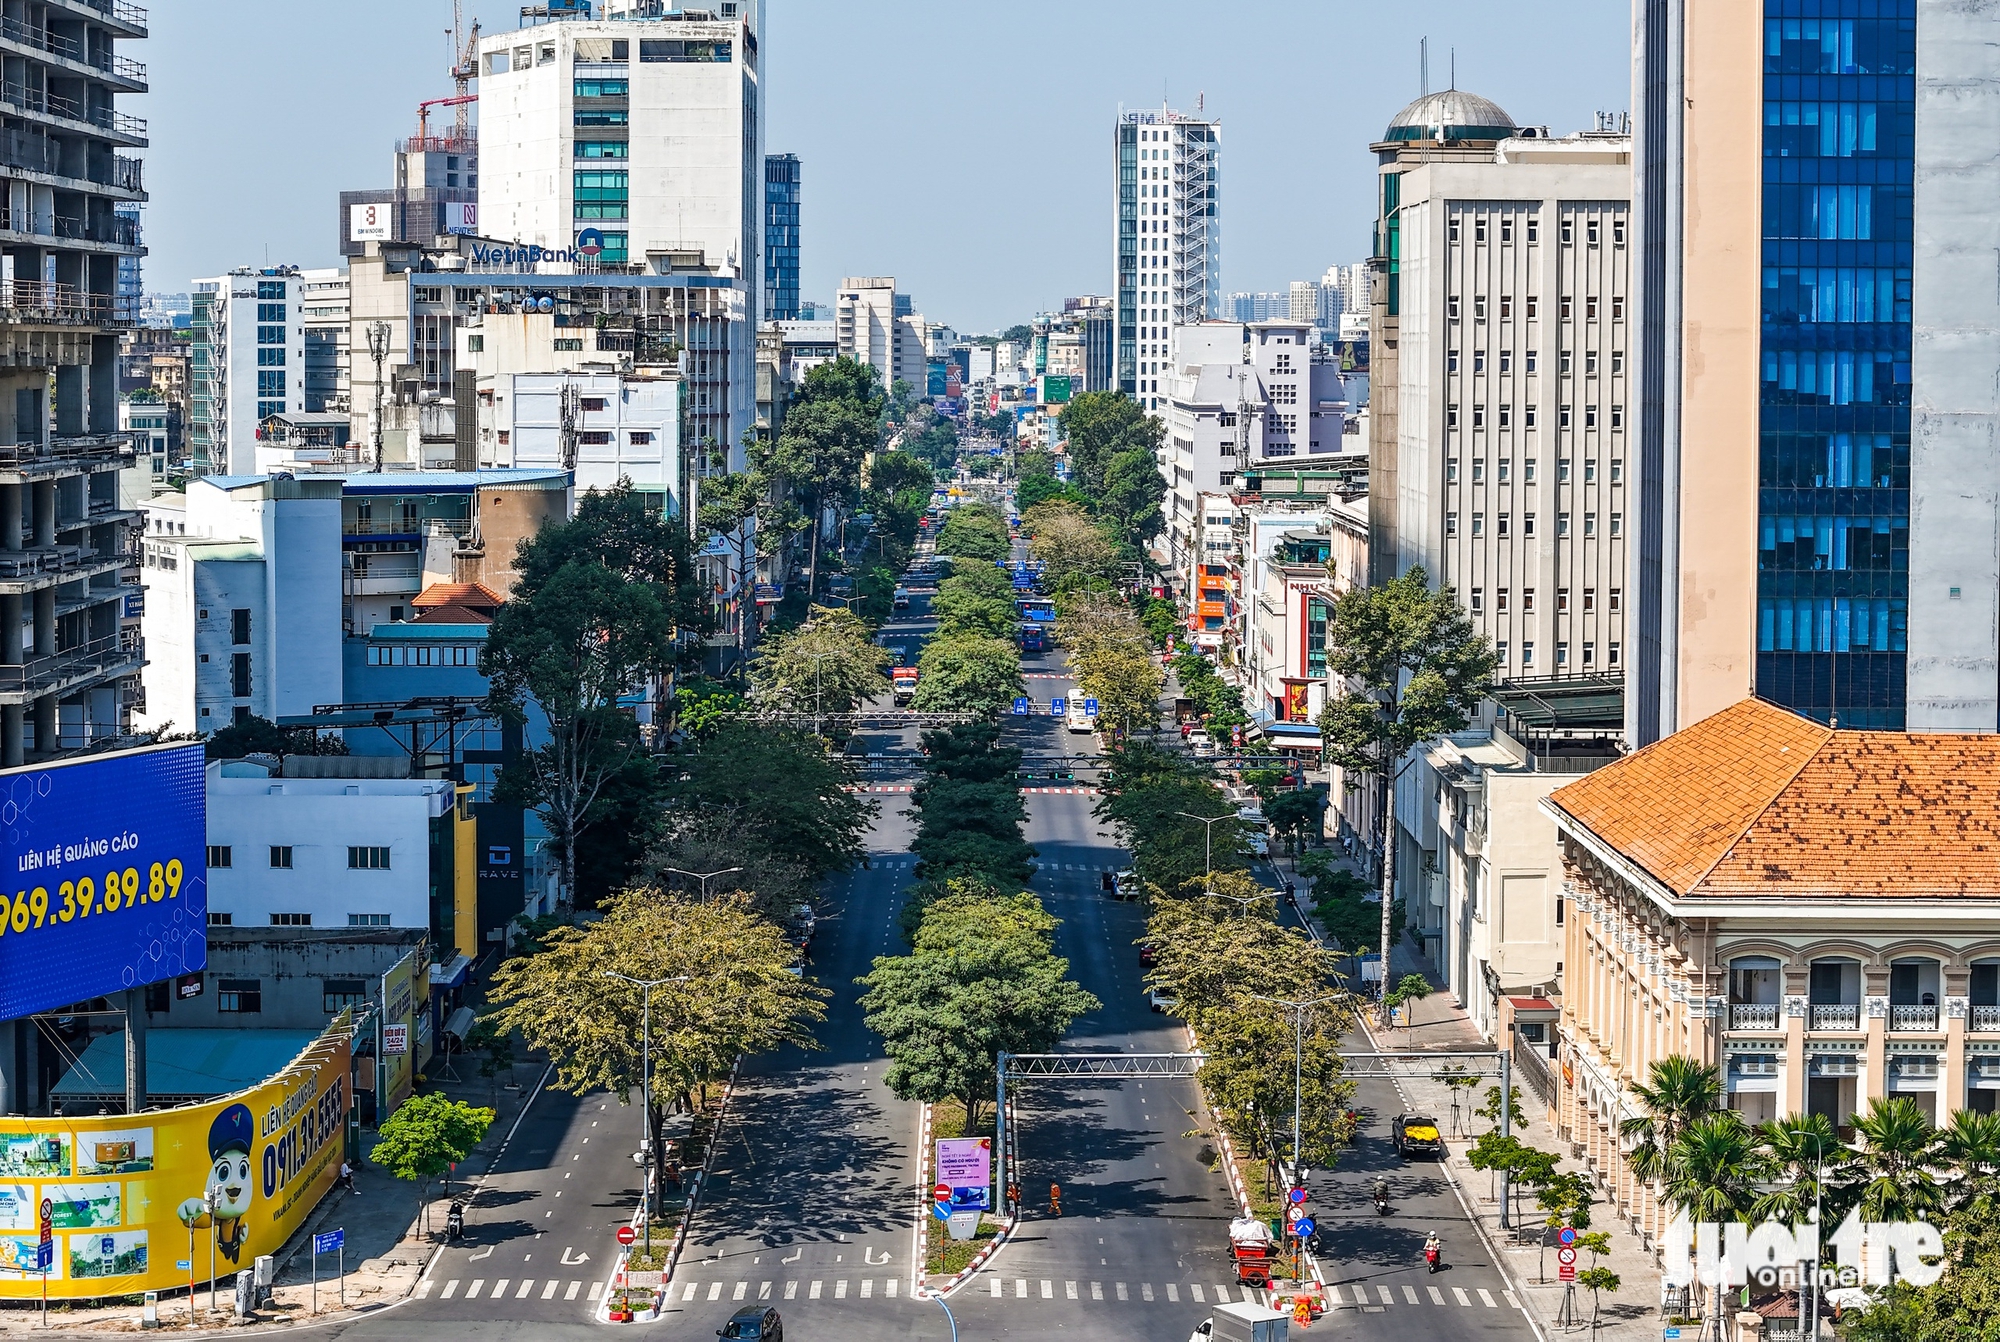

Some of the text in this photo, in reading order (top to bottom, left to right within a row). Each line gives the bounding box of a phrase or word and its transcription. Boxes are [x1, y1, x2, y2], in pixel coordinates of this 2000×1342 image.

[471, 243, 580, 264] VietinBank
[18, 830, 139, 872] LIÊN HỆ QUẢNG CÁO
[480, 870, 519, 879] RAVE
[261, 1104, 282, 1139] LIÊN
[282, 1093, 292, 1128] HỆ
[263, 1073, 343, 1200] 0911.39.5555
